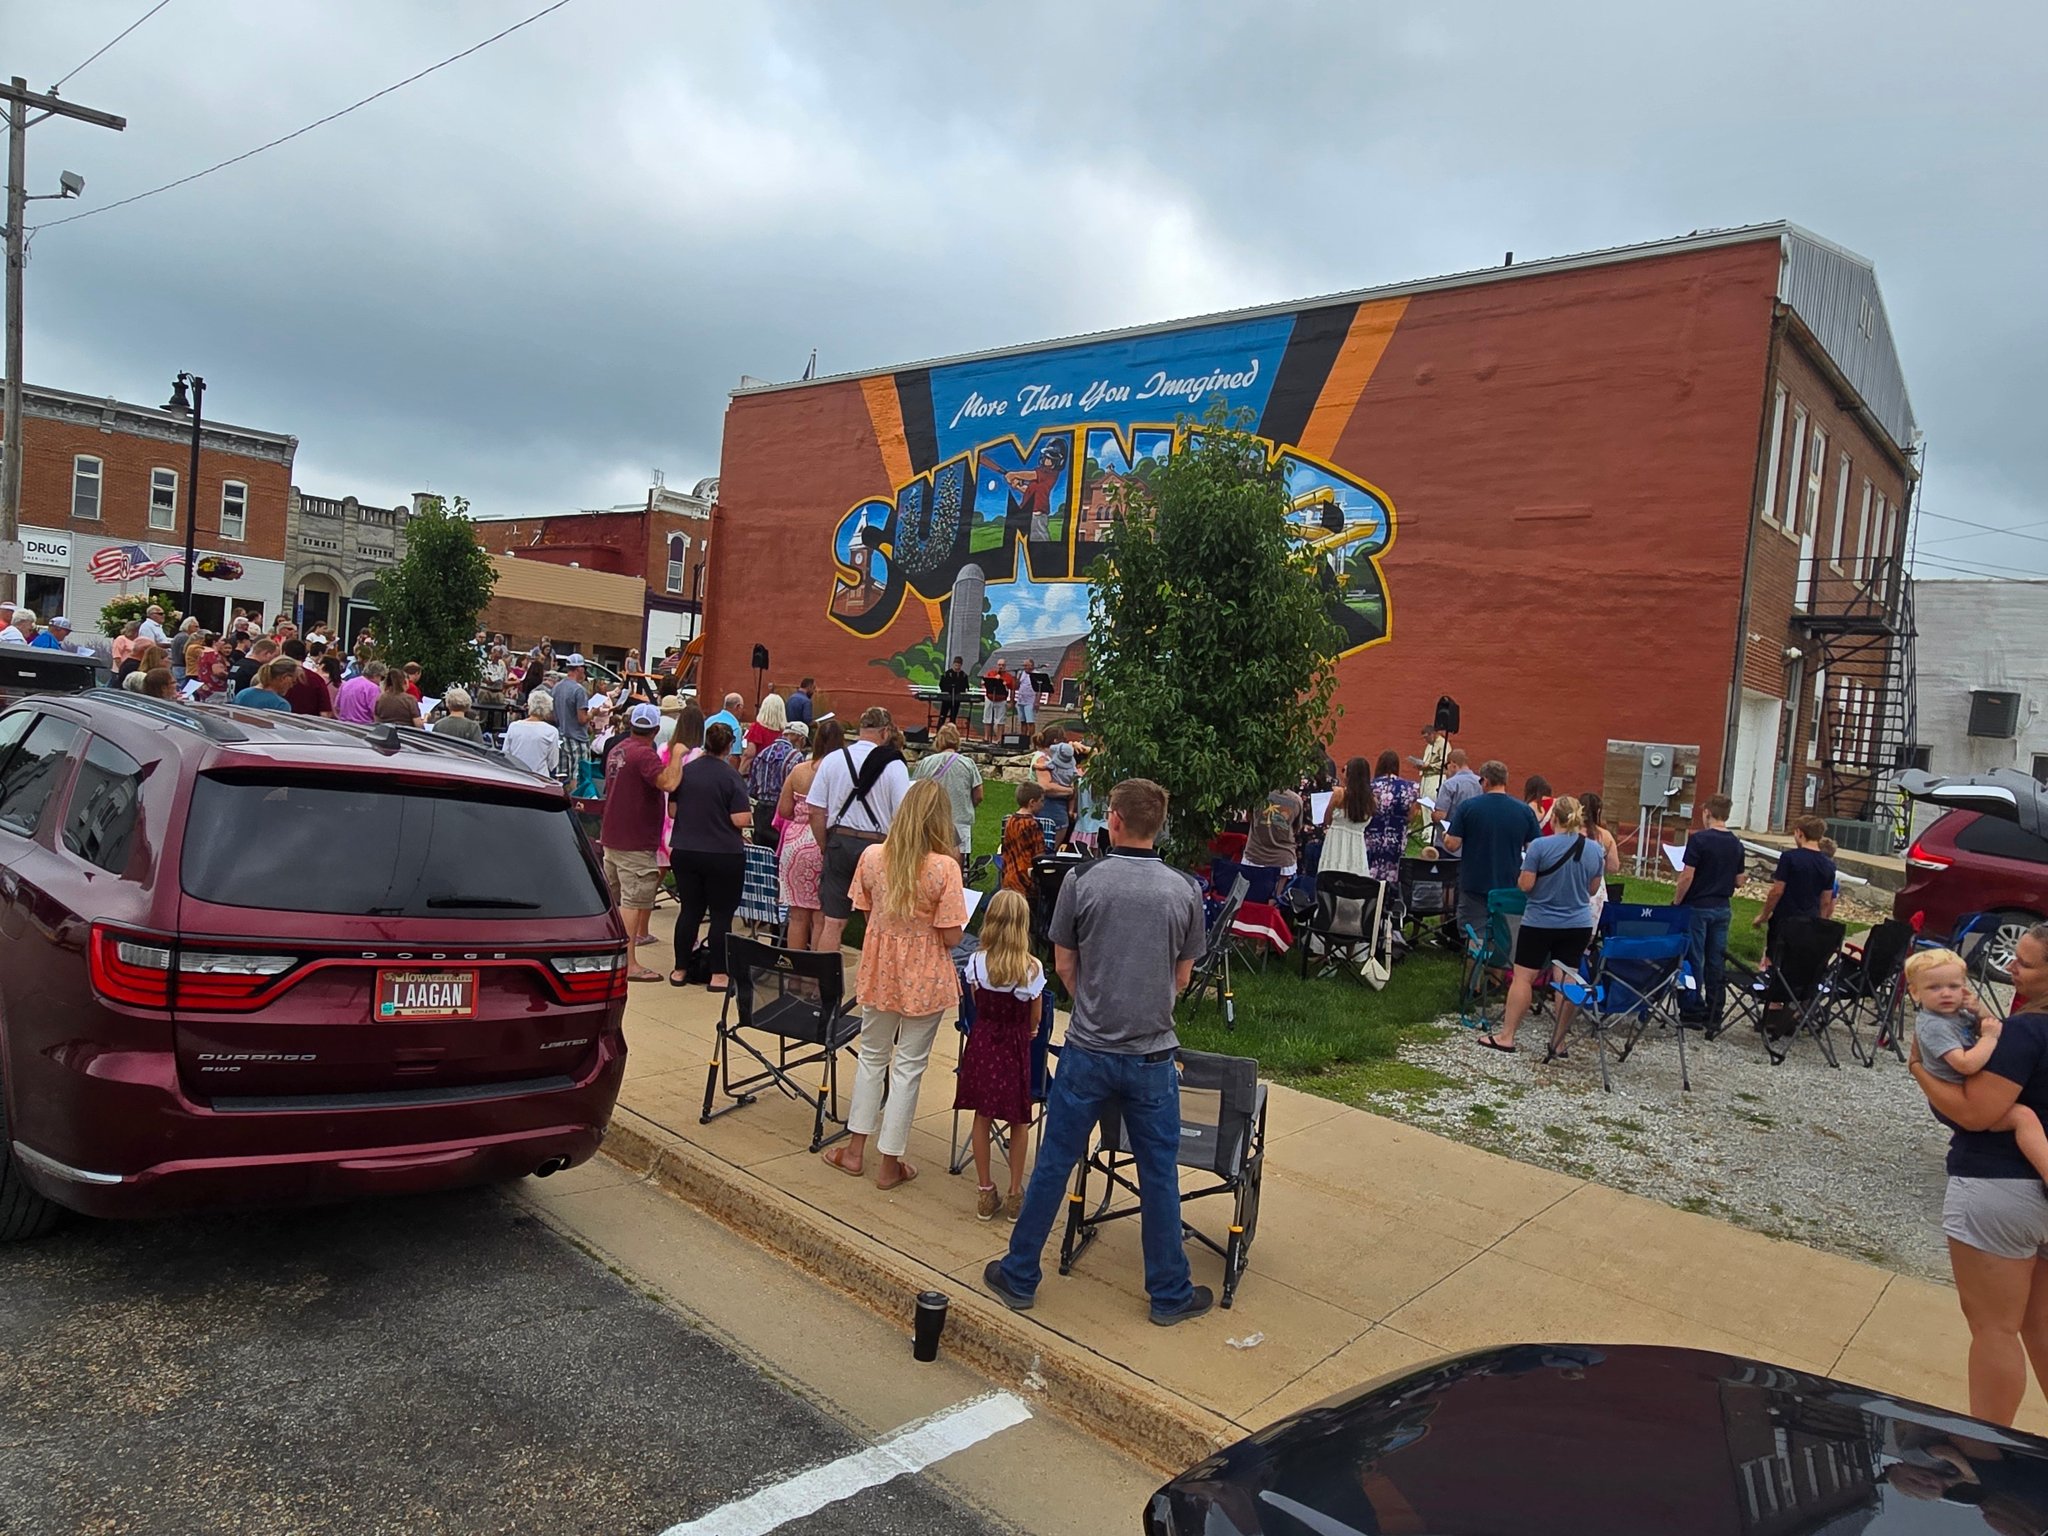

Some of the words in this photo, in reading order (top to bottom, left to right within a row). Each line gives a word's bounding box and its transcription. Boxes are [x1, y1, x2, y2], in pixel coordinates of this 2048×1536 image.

[949, 391, 1007, 430] More
[1017, 384, 1072, 417] Than
[1079, 379, 1130, 413] You
[1136, 359, 1259, 403] Imagined
[27, 541, 67, 556] DRUG
[827, 422, 1397, 663] SUMNR
[361, 952, 506, 960] DODGE
[394, 983, 462, 1007] LAAGAN
[539, 1038, 588, 1050] LIMITED
[197, 1053, 317, 1061] DURANGO
